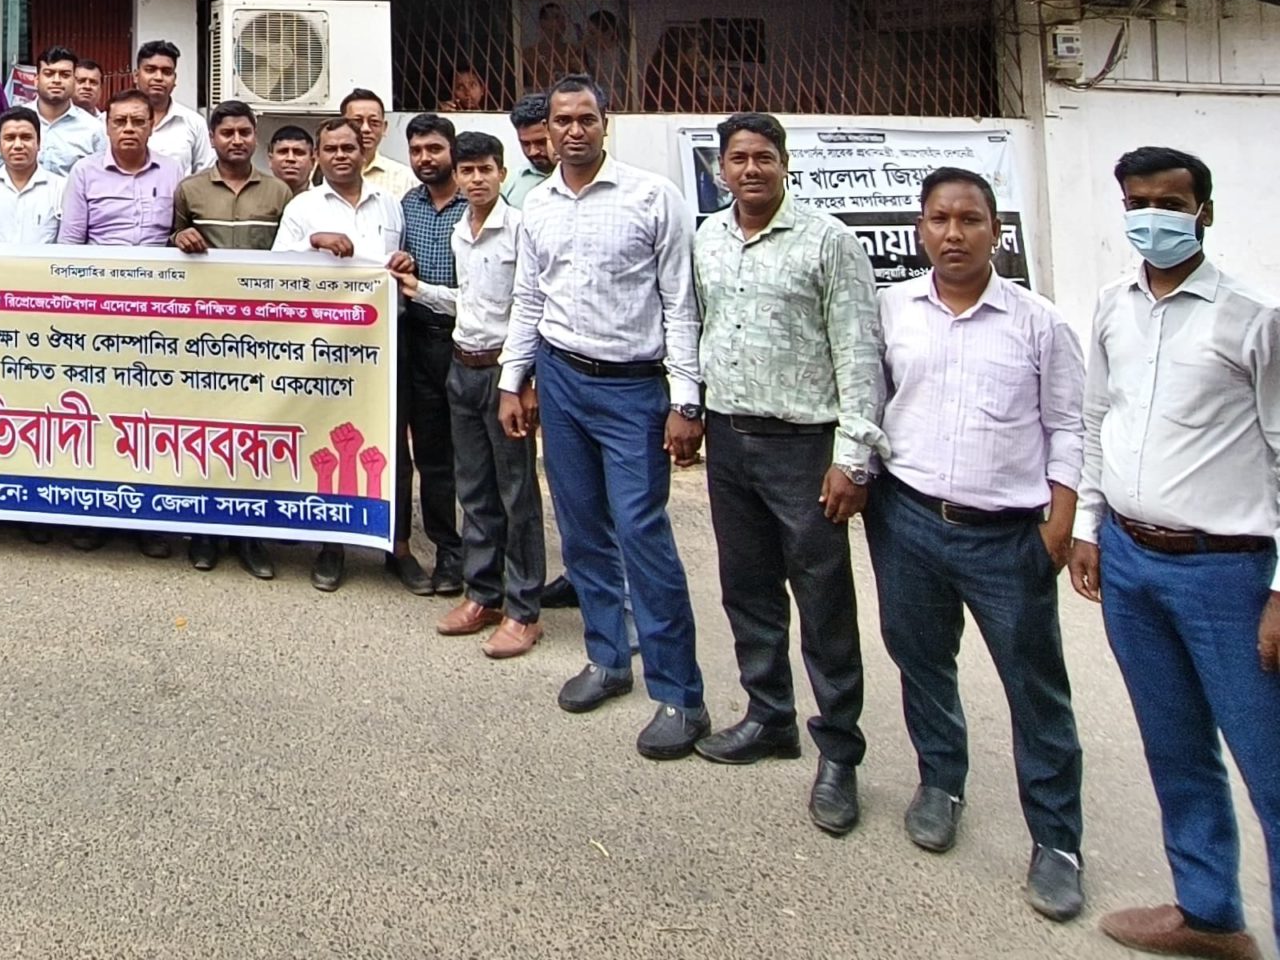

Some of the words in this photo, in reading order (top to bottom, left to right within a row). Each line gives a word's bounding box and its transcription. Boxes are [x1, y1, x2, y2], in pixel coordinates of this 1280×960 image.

[809, 168, 876, 189] খালেদা
[238, 277, 274, 289] আমরা
[279, 277, 311, 291] সবাই
[316, 280, 339, 292] এক
[100, 300, 148, 313] এদেশের
[195, 300, 236, 317] শিক্ষিত
[241, 306, 252, 316] ও
[254, 302, 307, 319] প্রশিক্ষিত
[311, 304, 367, 322] জনগোষ্ঠী
[26, 331, 40, 348] ও
[46, 324, 86, 352] ঔষধ
[92, 330, 179, 356] কোম্পানির
[184, 331, 305, 362] প্রতিনিধিগণের
[310, 336, 381, 365] নিরাপদ
[0, 355, 55, 382] নিশ্চিত
[60, 364, 107, 385] করার
[112, 361, 174, 388] দাবীতে
[179, 368, 265, 393] সারাদেশে
[271, 374, 355, 398] একযোগে
[108, 408, 308, 482] মানববন্ধন
[36, 484, 144, 514] খাগড়াছড়ি
[151, 494, 208, 515] জেলা
[214, 495, 269, 518] সদর
